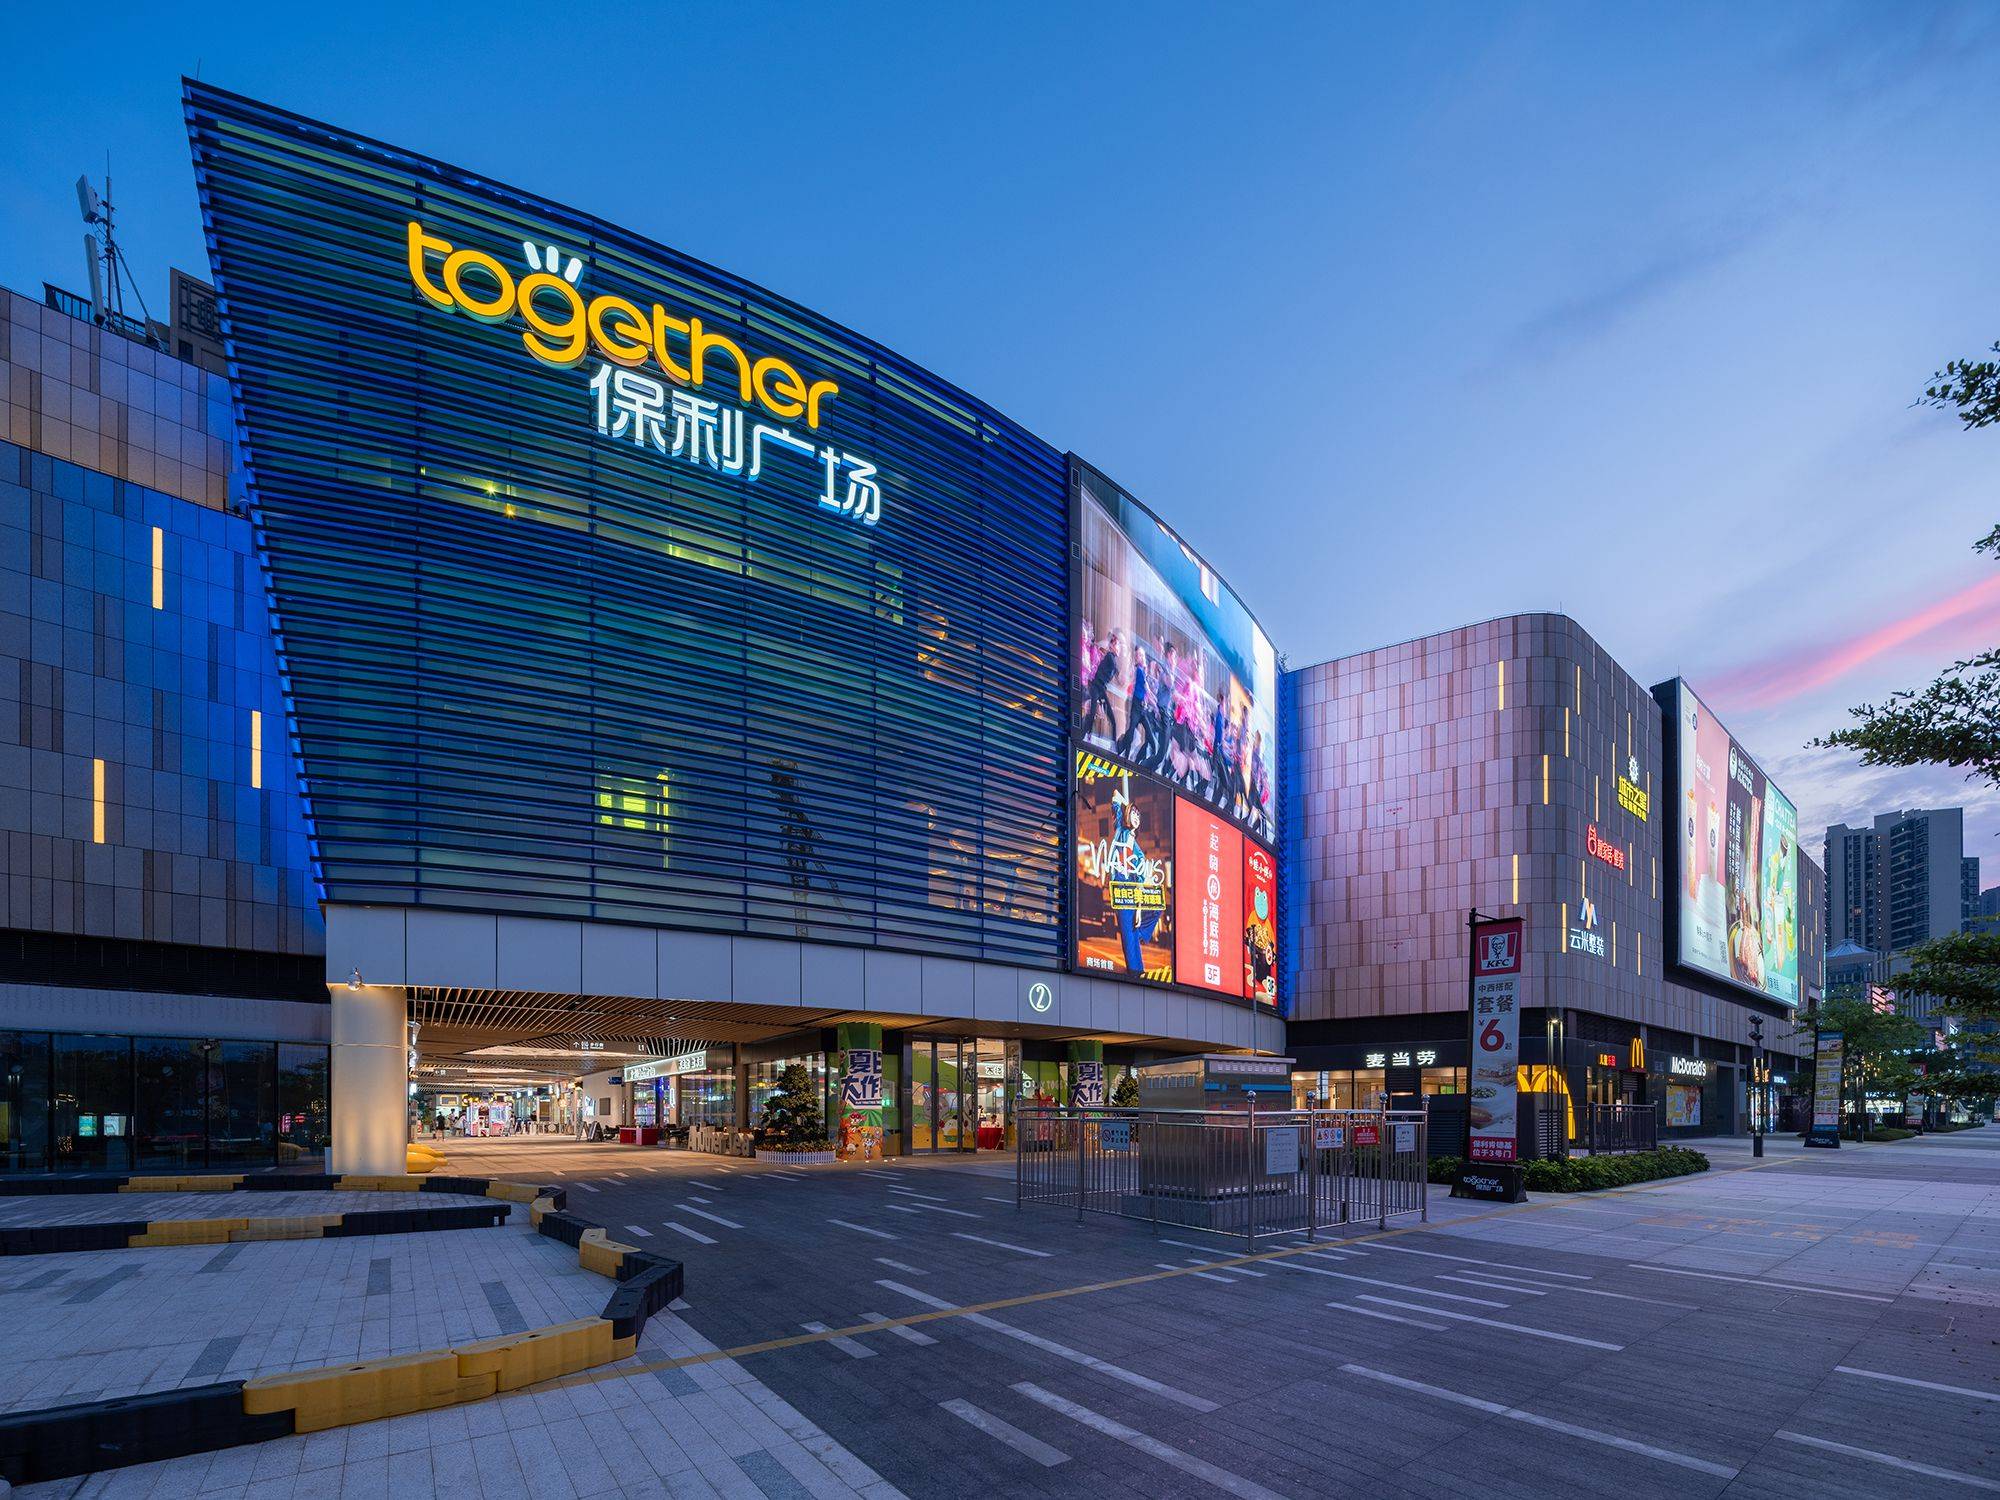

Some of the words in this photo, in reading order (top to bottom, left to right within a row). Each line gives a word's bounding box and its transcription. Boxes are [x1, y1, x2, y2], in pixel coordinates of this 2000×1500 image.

[408, 221, 839, 430] together
[590, 364, 881, 525] 保利广场
[1570, 928, 1605, 957] 云米整装
[1486, 958, 1509, 968] KFC
[1207, 967, 1218, 981] 3F
[1478, 981, 1514, 993] 中西搭配
[1477, 994, 1514, 1014] 套餐
[1366, 1050, 1436, 1068] 麦当劳
[1671, 1056, 1707, 1076] McDonald's
